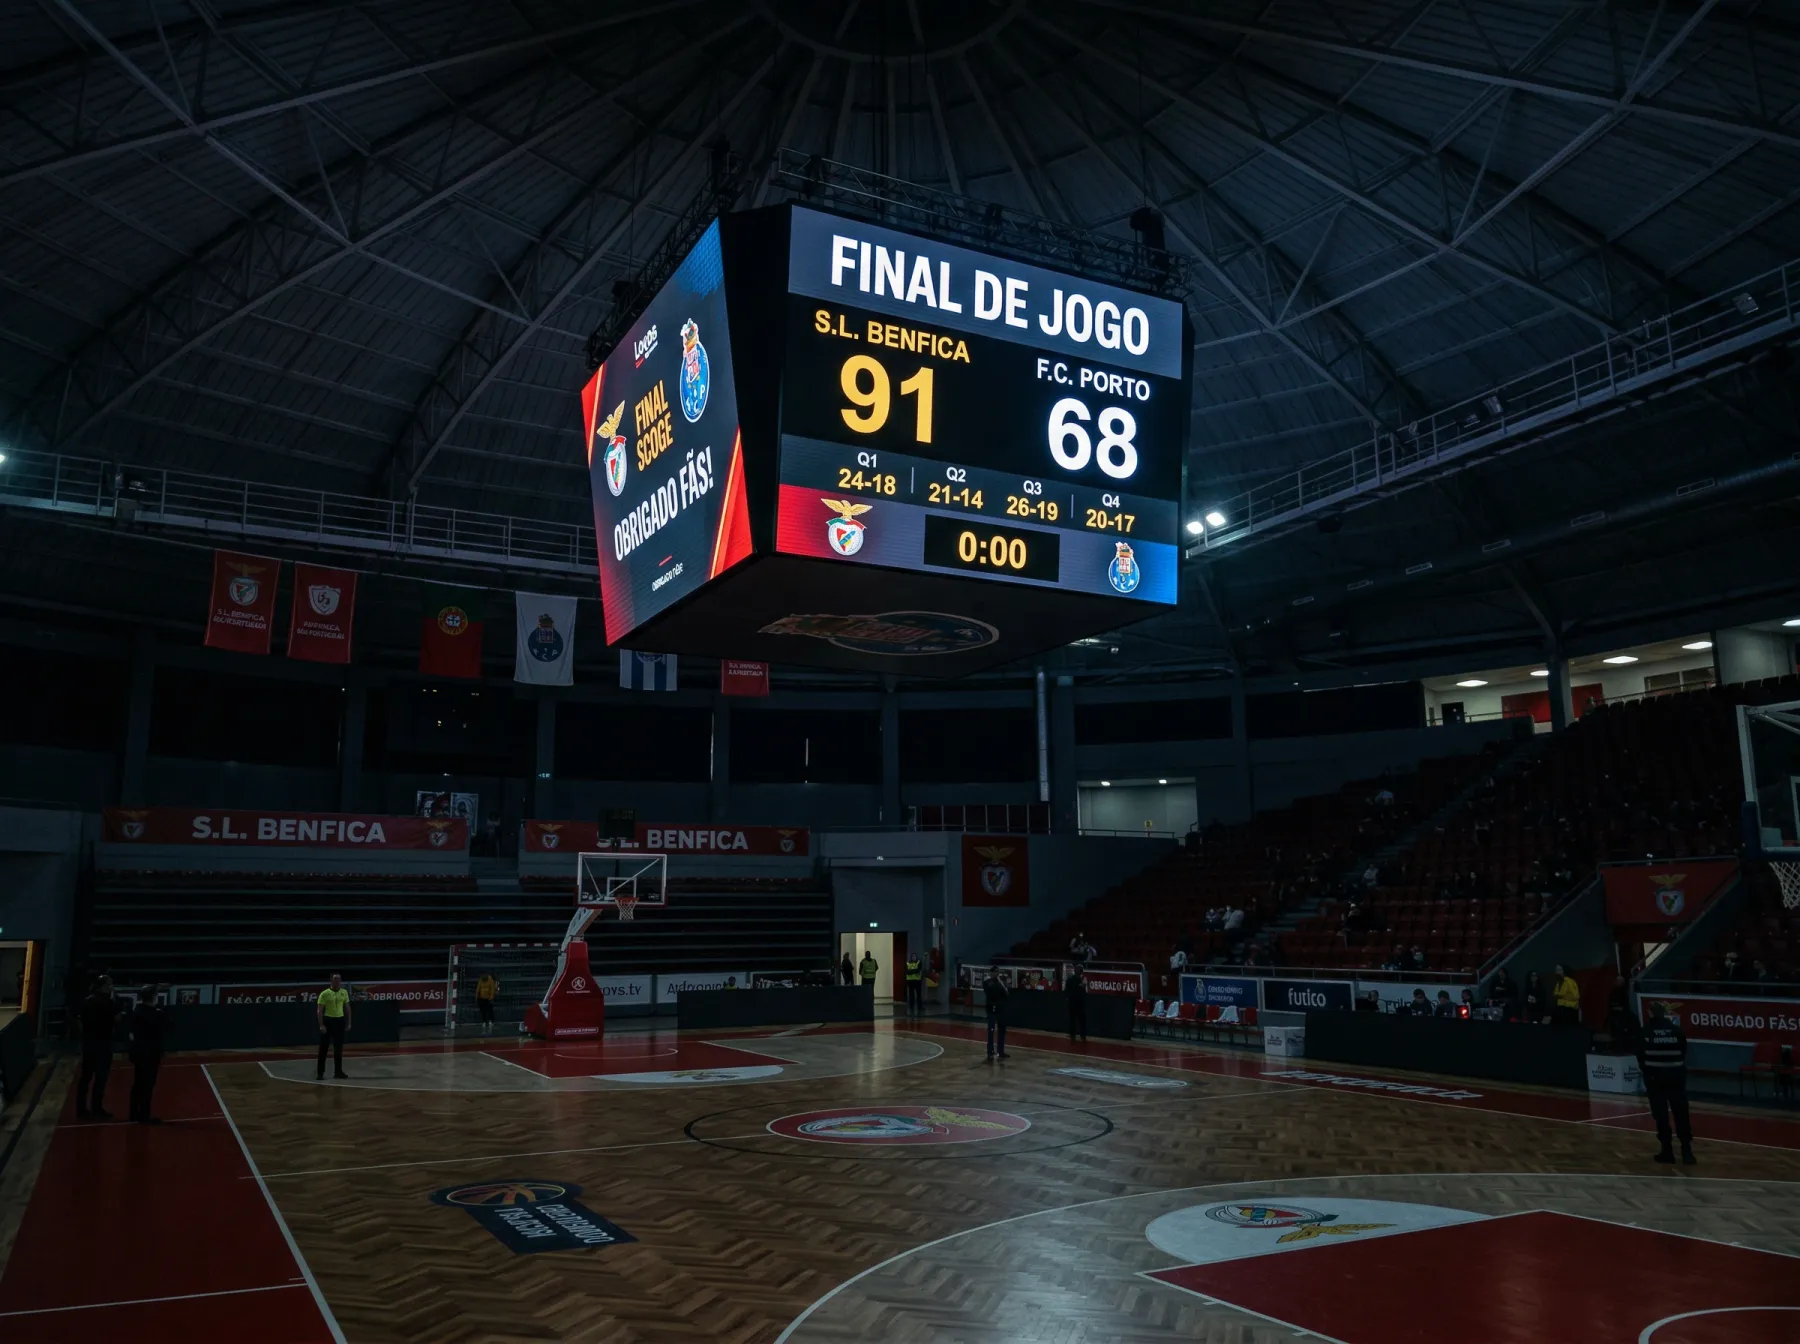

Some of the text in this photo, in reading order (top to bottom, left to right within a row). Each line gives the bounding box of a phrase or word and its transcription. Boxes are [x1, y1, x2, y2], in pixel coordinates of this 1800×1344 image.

[831, 234, 1150, 355] FINAL DE JOGO
[815, 310, 970, 363] S.L. BENFICA
[1036, 358, 1151, 401] F.C. PORTO
[635, 380, 669, 436] FINAL
[840, 355, 934, 444] 91
[636, 412, 674, 472] SCOGE
[1048, 397, 1138, 479] 68
[857, 451, 878, 468] Q1
[838, 467, 897, 495] 24-18
[946, 466, 966, 483] Q2
[1023, 479, 1042, 496] Q3
[614, 446, 714, 561] OBRIGADO FÃS!
[928, 483, 984, 509] 21-14
[1006, 496, 1059, 522] 26-19
[1102, 494, 1120, 508] Q4
[1085, 508, 1135, 534] 20-17
[958, 531, 1027, 569] 0:00
[192, 816, 386, 843] S.L. BENFICA
[647, 829, 749, 850] BENFICA
[373, 990, 444, 1001] OBRIGADO FÃS!
[1691, 1013, 1765, 1029] OBRIGADO
